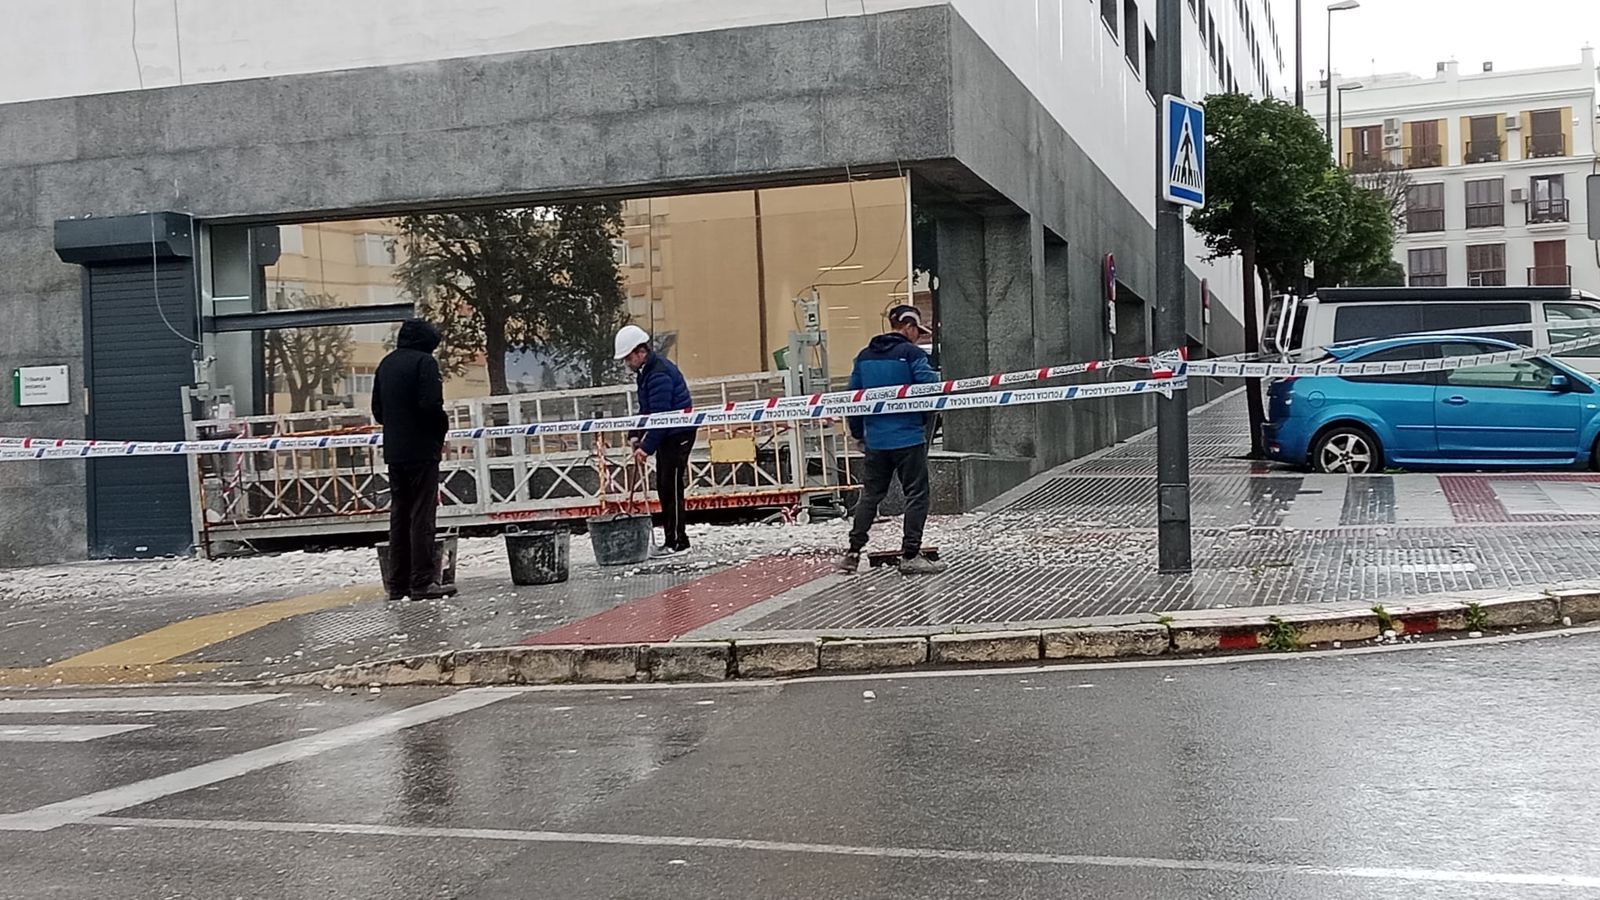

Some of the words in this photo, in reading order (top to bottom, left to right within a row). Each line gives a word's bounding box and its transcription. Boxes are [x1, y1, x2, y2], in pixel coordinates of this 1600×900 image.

[1080, 387, 1103, 396] LOCAL
[1014, 392, 1036, 401] LOCAL
[886, 401, 907, 410] LOCAL
[949, 397, 970, 406] LOCAL
[766, 410, 785, 418] LOCAL
[825, 406, 845, 415] LOCAL
